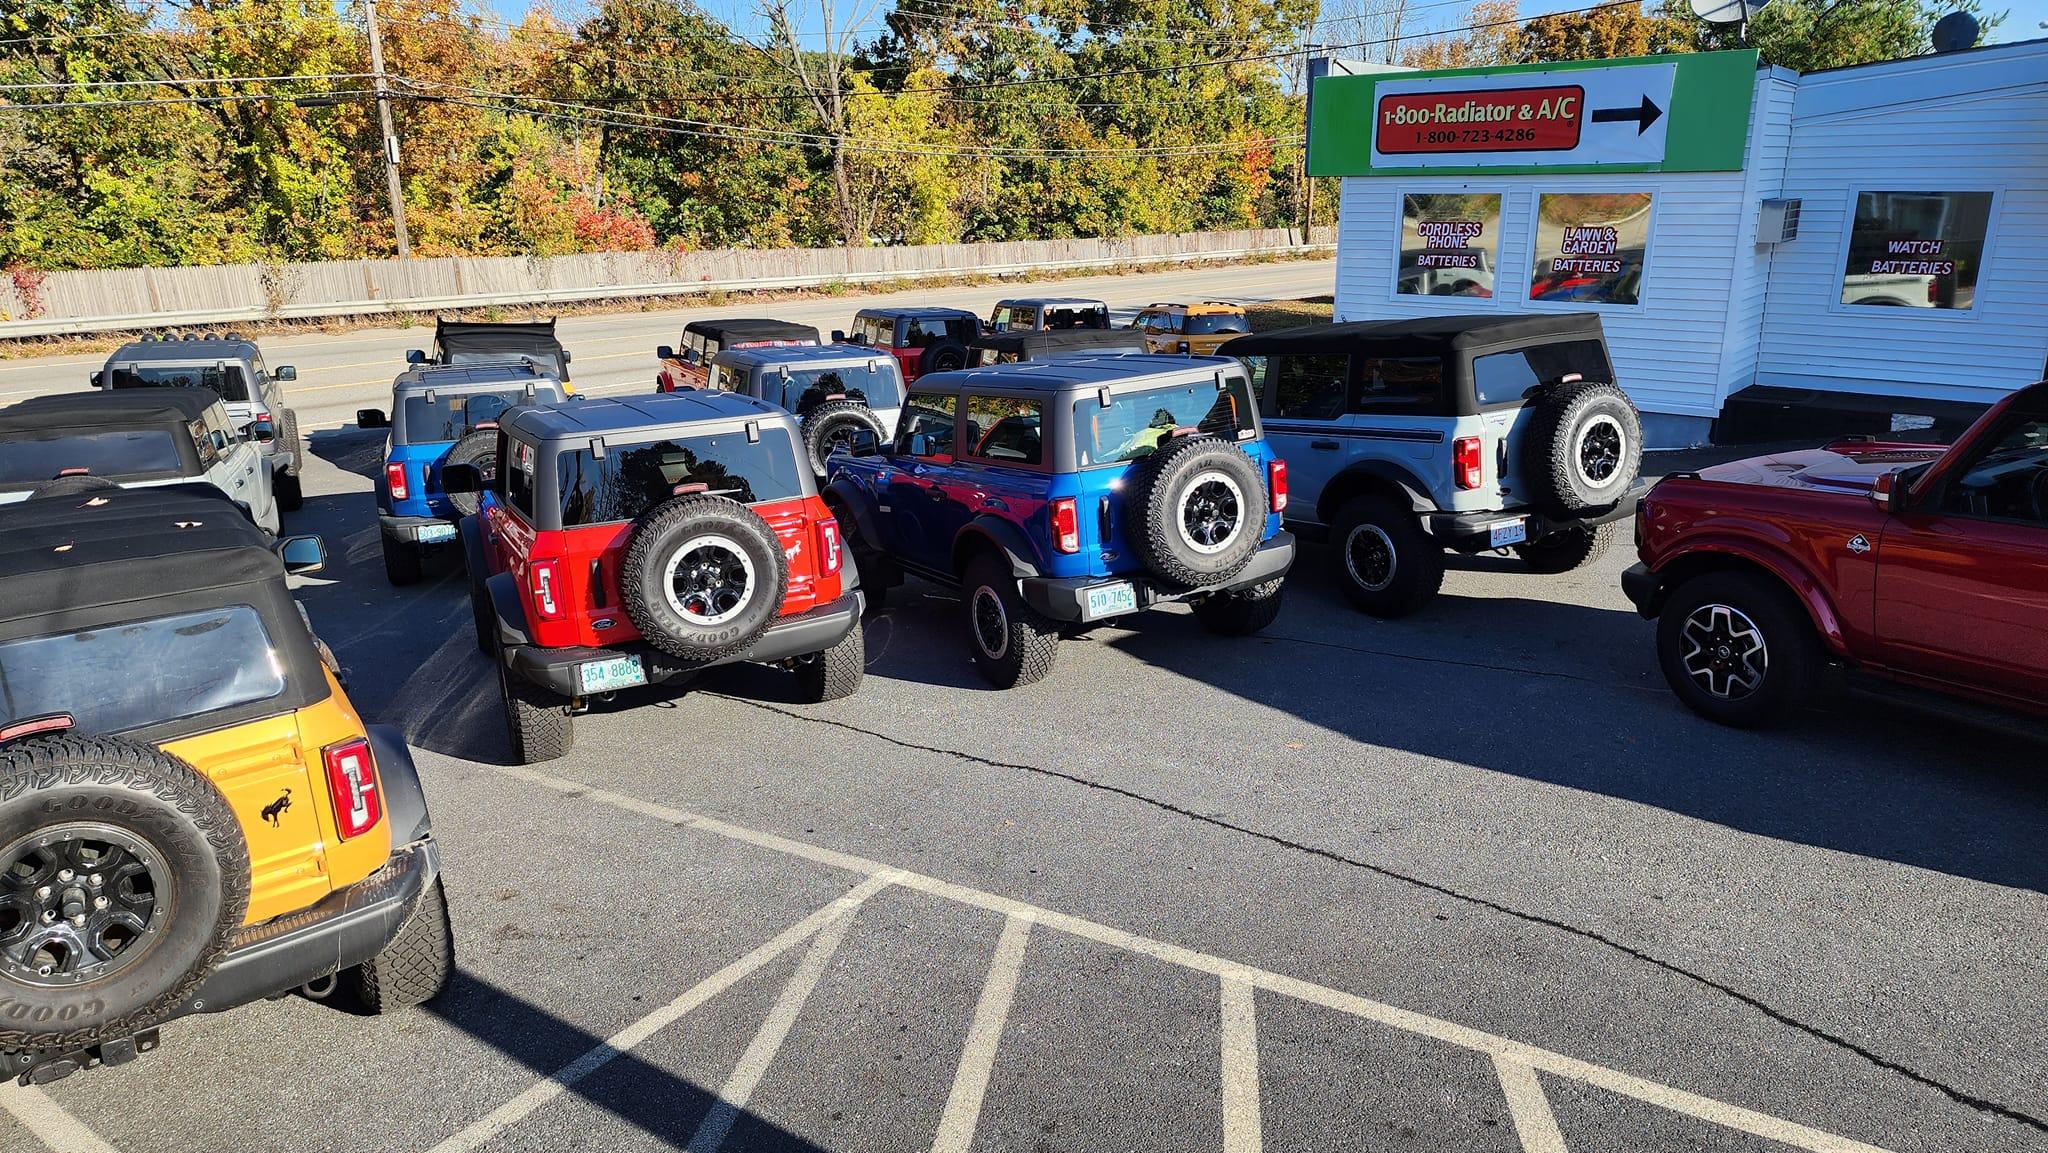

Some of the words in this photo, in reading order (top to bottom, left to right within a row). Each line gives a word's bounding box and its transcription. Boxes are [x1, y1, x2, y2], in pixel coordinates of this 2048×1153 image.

[1384, 101, 1516, 125] 1-800-Radiator
[1518, 104, 1533, 121] &
[1537, 97, 1576, 120] A/C
[1415, 128, 1536, 144] 1-800-723-4286
[1418, 223, 1481, 236] CORDLESS
[1564, 228, 1601, 241] LAWN
[1604, 228, 1617, 241] &
[1428, 236, 1468, 249] PHONE
[1562, 241, 1615, 254] GARDEN
[1888, 241, 1941, 254] WATCH
[1418, 254, 1477, 267] BATTERIES
[1553, 259, 1621, 273] BATTERIES
[1871, 260, 1953, 275] BATTERIES
[583, 666, 605, 683] 354
[611, 660, 639, 678] 8888
